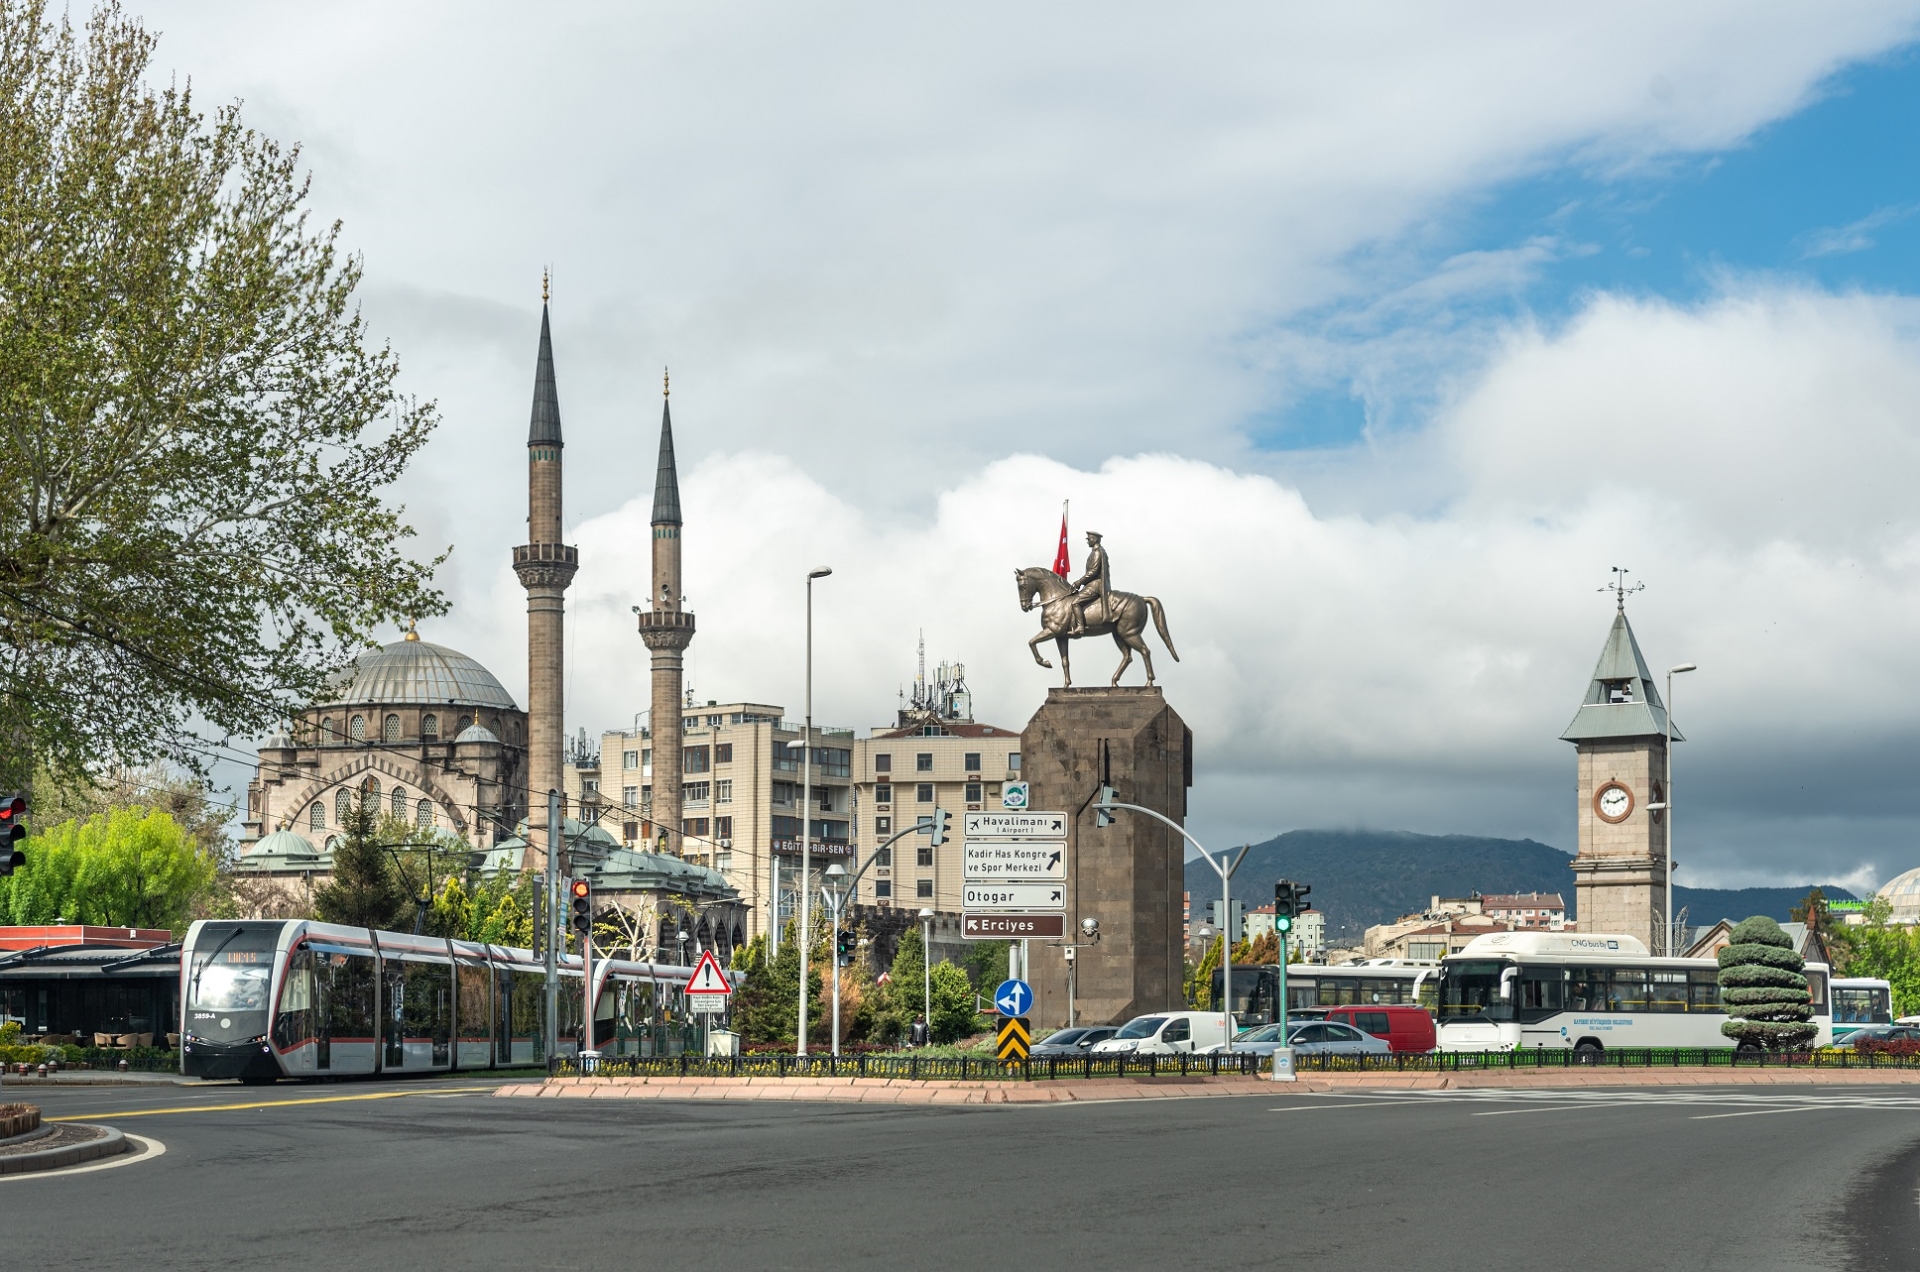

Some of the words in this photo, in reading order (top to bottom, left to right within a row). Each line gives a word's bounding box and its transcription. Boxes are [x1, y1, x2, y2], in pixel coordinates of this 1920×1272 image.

[983, 817, 1047, 826] Havalimanı
[968, 849, 993, 859] Kadir
[995, 849, 1012, 859] Has
[1014, 849, 1047, 860] Kongre
[968, 864, 979, 872] ve
[981, 863, 1002, 873] Spor
[1005, 863, 1042, 872] Merkezi
[967, 890, 1015, 903] Otogar
[981, 919, 1034, 932] Erciyes
[1571, 940, 1588, 948] CNG
